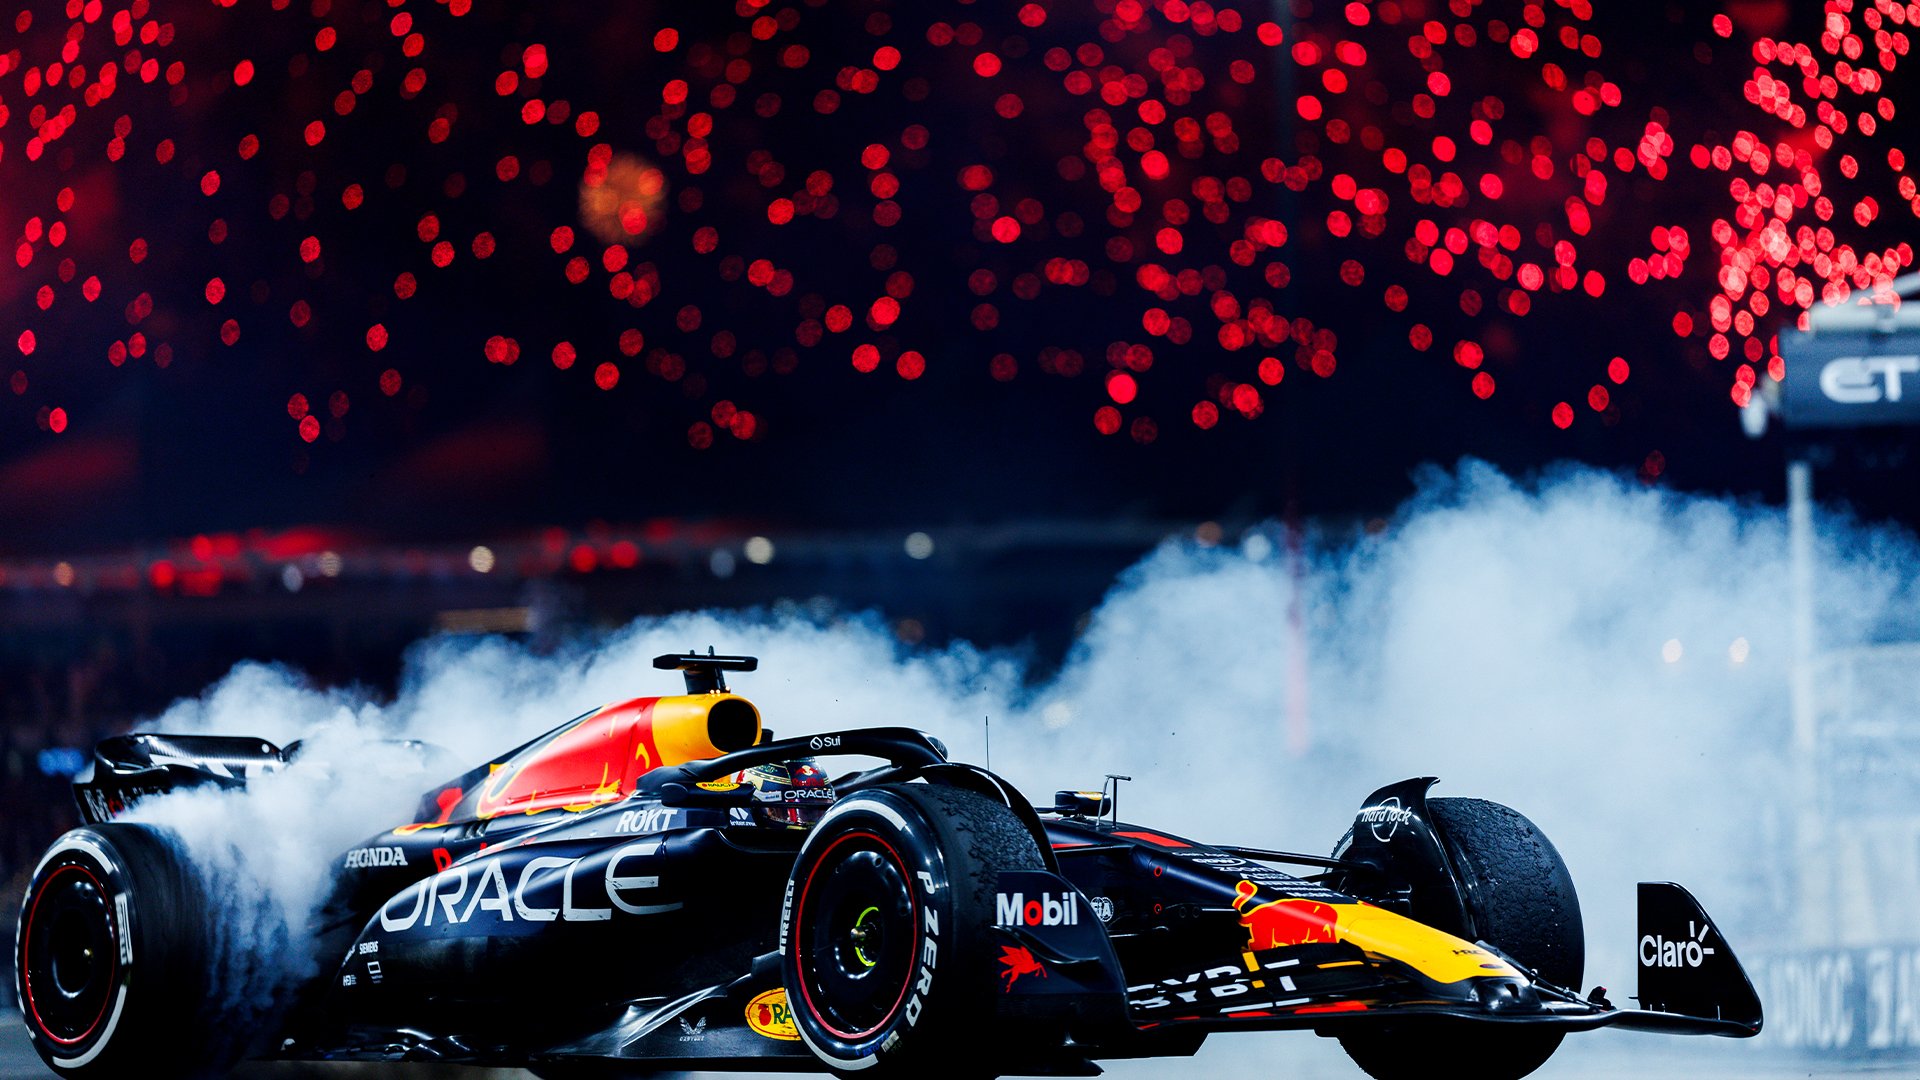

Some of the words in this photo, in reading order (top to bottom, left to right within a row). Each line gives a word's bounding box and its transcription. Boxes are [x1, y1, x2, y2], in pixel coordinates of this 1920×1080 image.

[824, 736, 841, 747] Sui
[785, 789, 832, 800] ORACLE
[615, 809, 678, 833] ROKT
[344, 847, 408, 869] HONDA
[381, 843, 683, 933] ORACLE
[917, 871, 936, 895] P
[996, 891, 1078, 927] Mobil
[359, 941, 379, 955] SIEMENS
[1640, 933, 1704, 968] Claro
[906, 905, 940, 1027] ZERO
